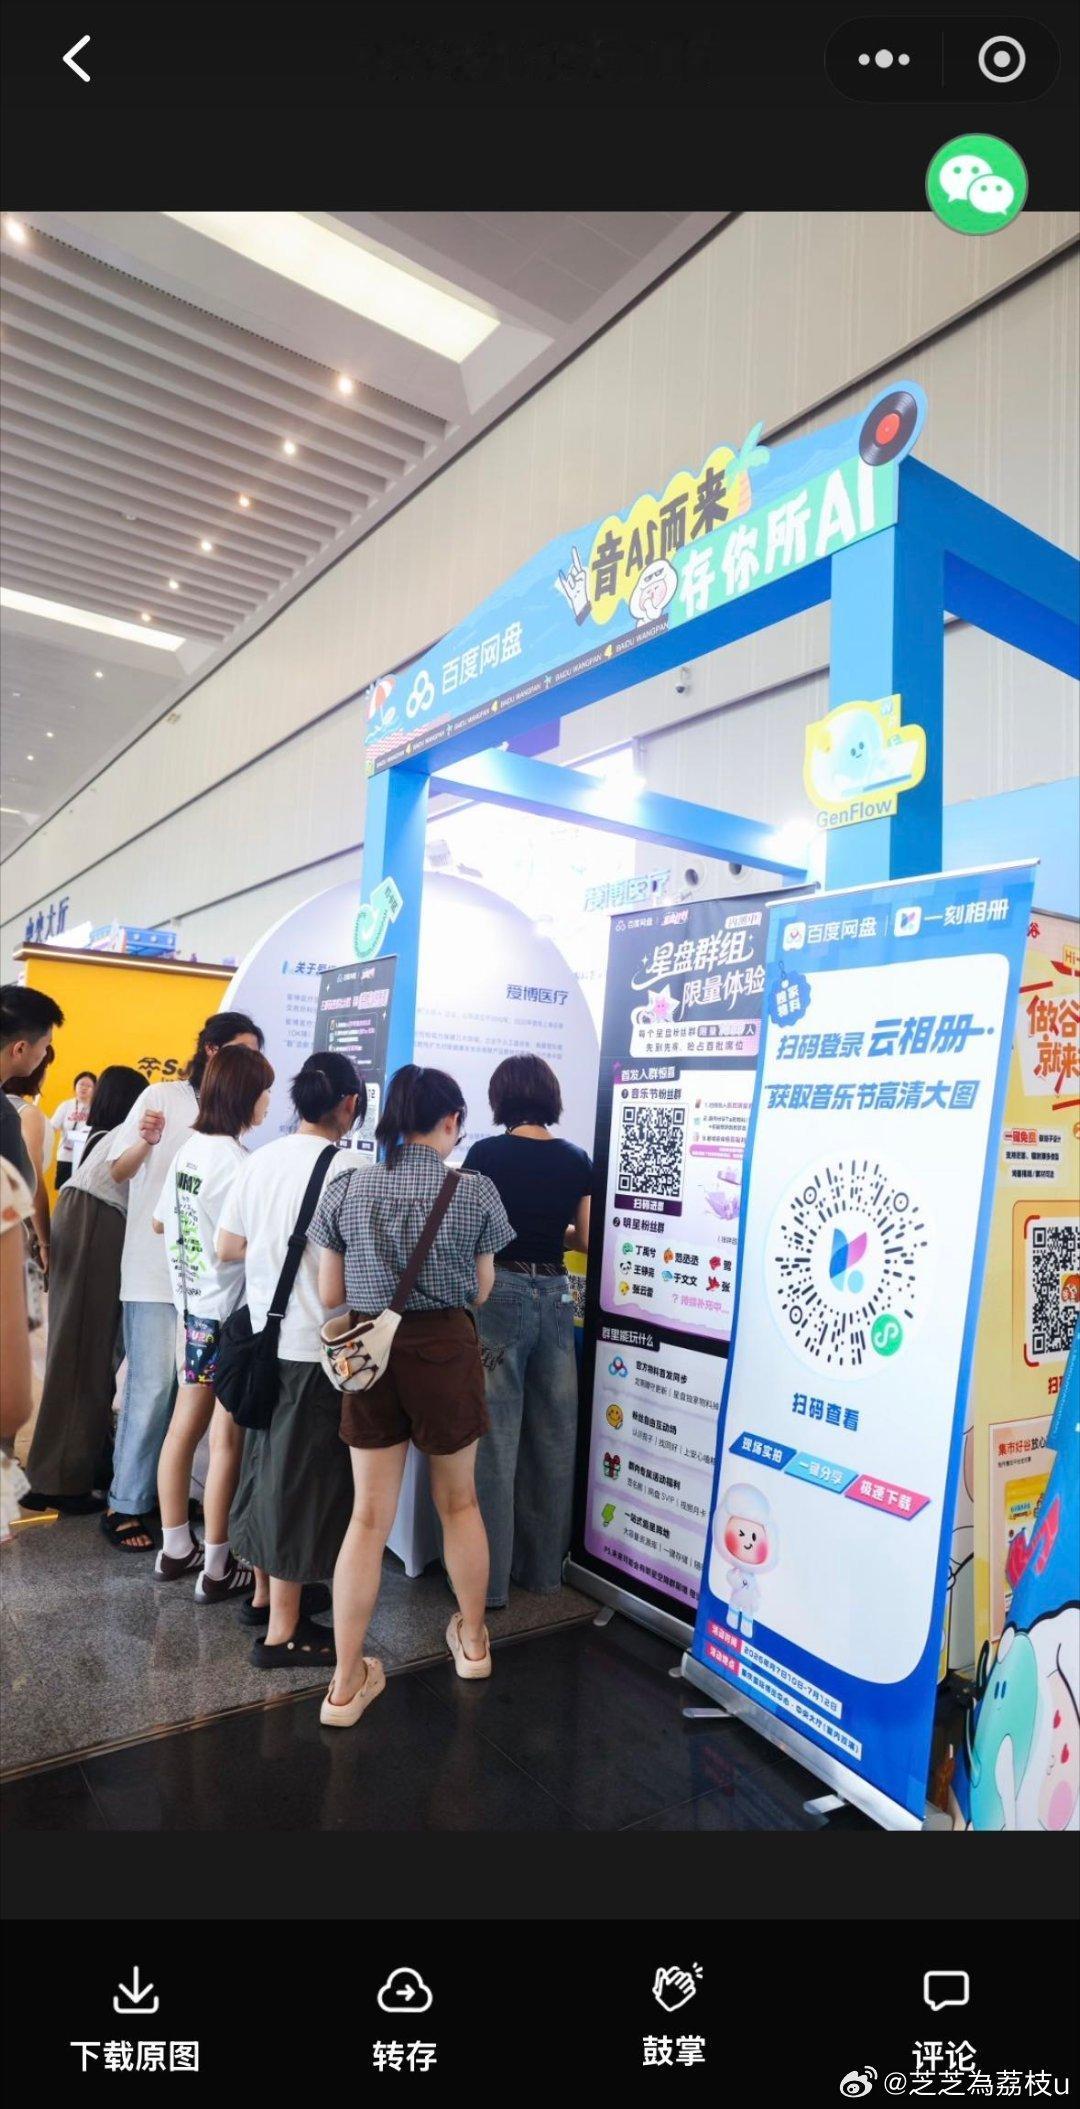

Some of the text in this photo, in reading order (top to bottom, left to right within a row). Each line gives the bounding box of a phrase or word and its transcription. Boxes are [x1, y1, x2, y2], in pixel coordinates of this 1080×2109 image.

[679, 460, 875, 618] 存你所AI
[616, 622, 670, 653] BAIDU WANGPAN
[442, 620, 523, 695] 百度网盘
[555, 654, 602, 682] BAIDU WANGPAN
[500, 684, 542, 709] BAIDU WANGPAN
[816, 799, 892, 828] GenFlow
[806, 897, 1010, 944] 百度网盘 一刻相册
[645, 929, 750, 977] 星盘群组
[506, 984, 569, 1005] 爱博医疗
[680, 965, 766, 1012] 限量体验
[776, 1014, 980, 1061] 扫码登录 云相册
[631, 1087, 682, 1100] 音乐节粉丝群
[764, 1078, 982, 1111] 获取音乐节高清大图
[622, 1216, 665, 1234] 明星粉丝群
[673, 1272, 698, 1287] 于文文
[602, 1326, 654, 1348] 群里能玩什么
[791, 1392, 860, 1432] 扫码查看
[741, 1436, 913, 1511] 现场实拍 一键分享 极速下载
